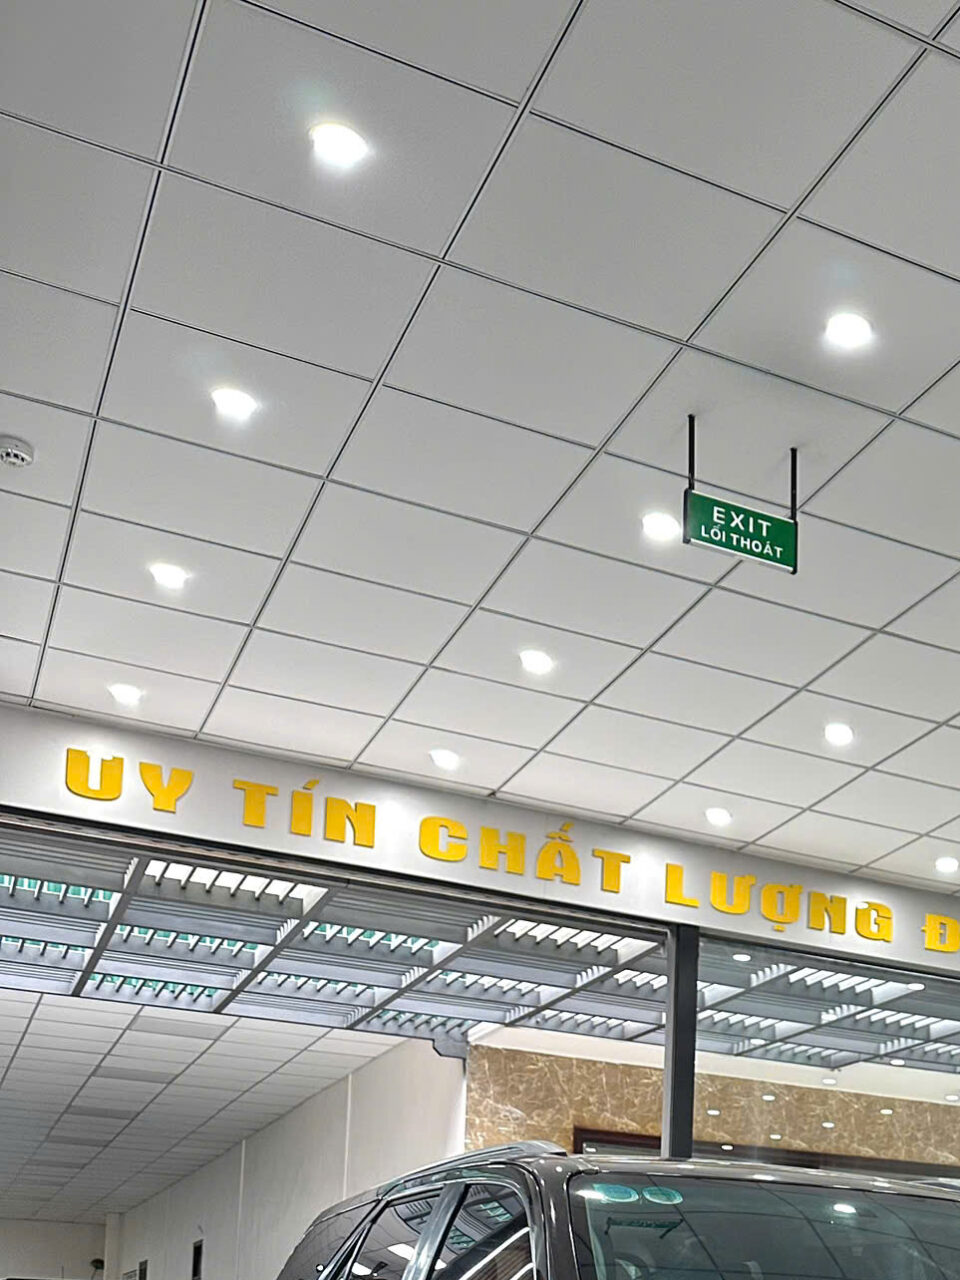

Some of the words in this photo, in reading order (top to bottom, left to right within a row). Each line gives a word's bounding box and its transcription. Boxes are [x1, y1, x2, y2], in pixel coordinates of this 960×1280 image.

[713, 505, 772, 537] EXIT
[701, 523, 726, 543] LỐI
[730, 531, 783, 559] THOÁT
[65, 748, 194, 814] UY
[232, 778, 377, 849] TÍN
[418, 816, 631, 895] CHẤT
[665, 863, 895, 943] LƯỢNG
